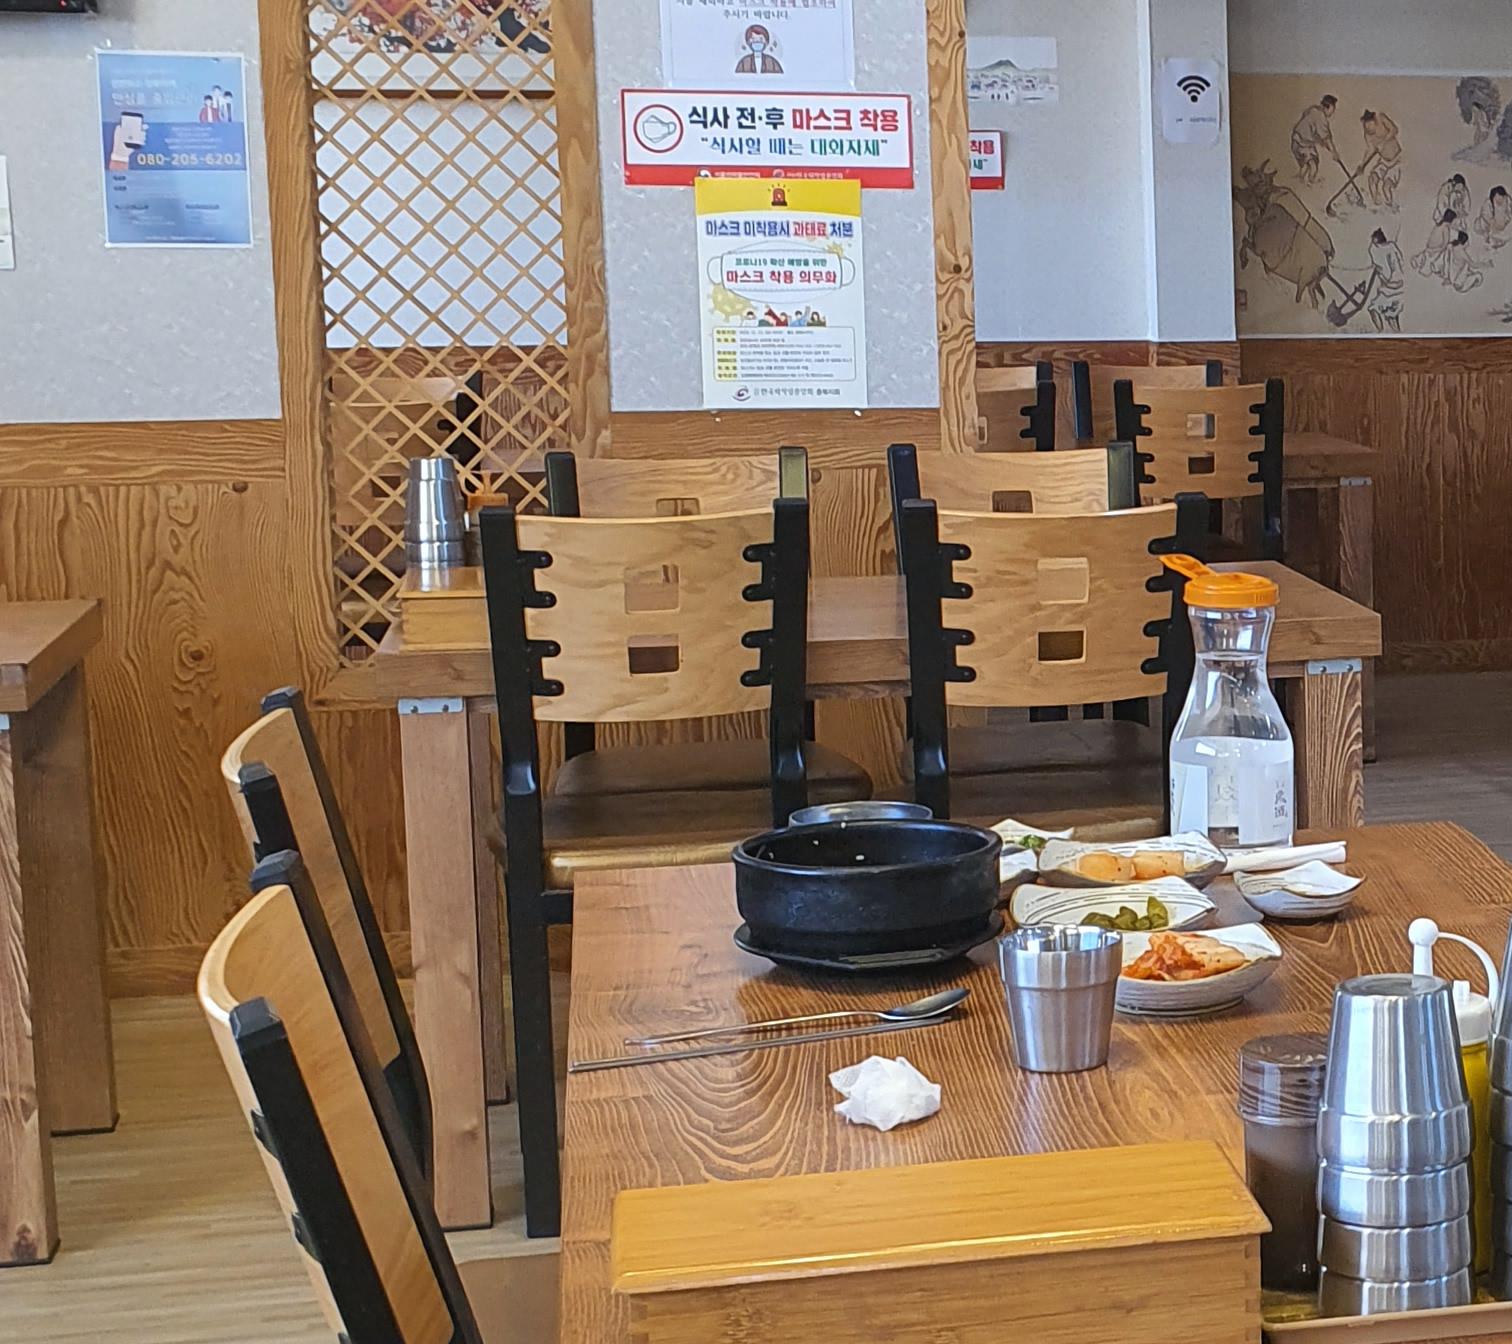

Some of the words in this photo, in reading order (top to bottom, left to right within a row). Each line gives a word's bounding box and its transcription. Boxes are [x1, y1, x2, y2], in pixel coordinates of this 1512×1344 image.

[688, 106, 730, 131] 식사
[735, 107, 785, 131] 전·후
[792, 108, 853, 132] 마스크
[859, 109, 900, 133] 착용
[768, 137, 804, 157] 때는
[705, 219, 741, 237] 마스크
[744, 219, 791, 238] 미착용시
[792, 220, 828, 237] 과태료
[829, 220, 854, 238] 처분
[726, 270, 765, 284] 마스크
[769, 270, 795, 285] 착용
[799, 270, 838, 285] 의무화
